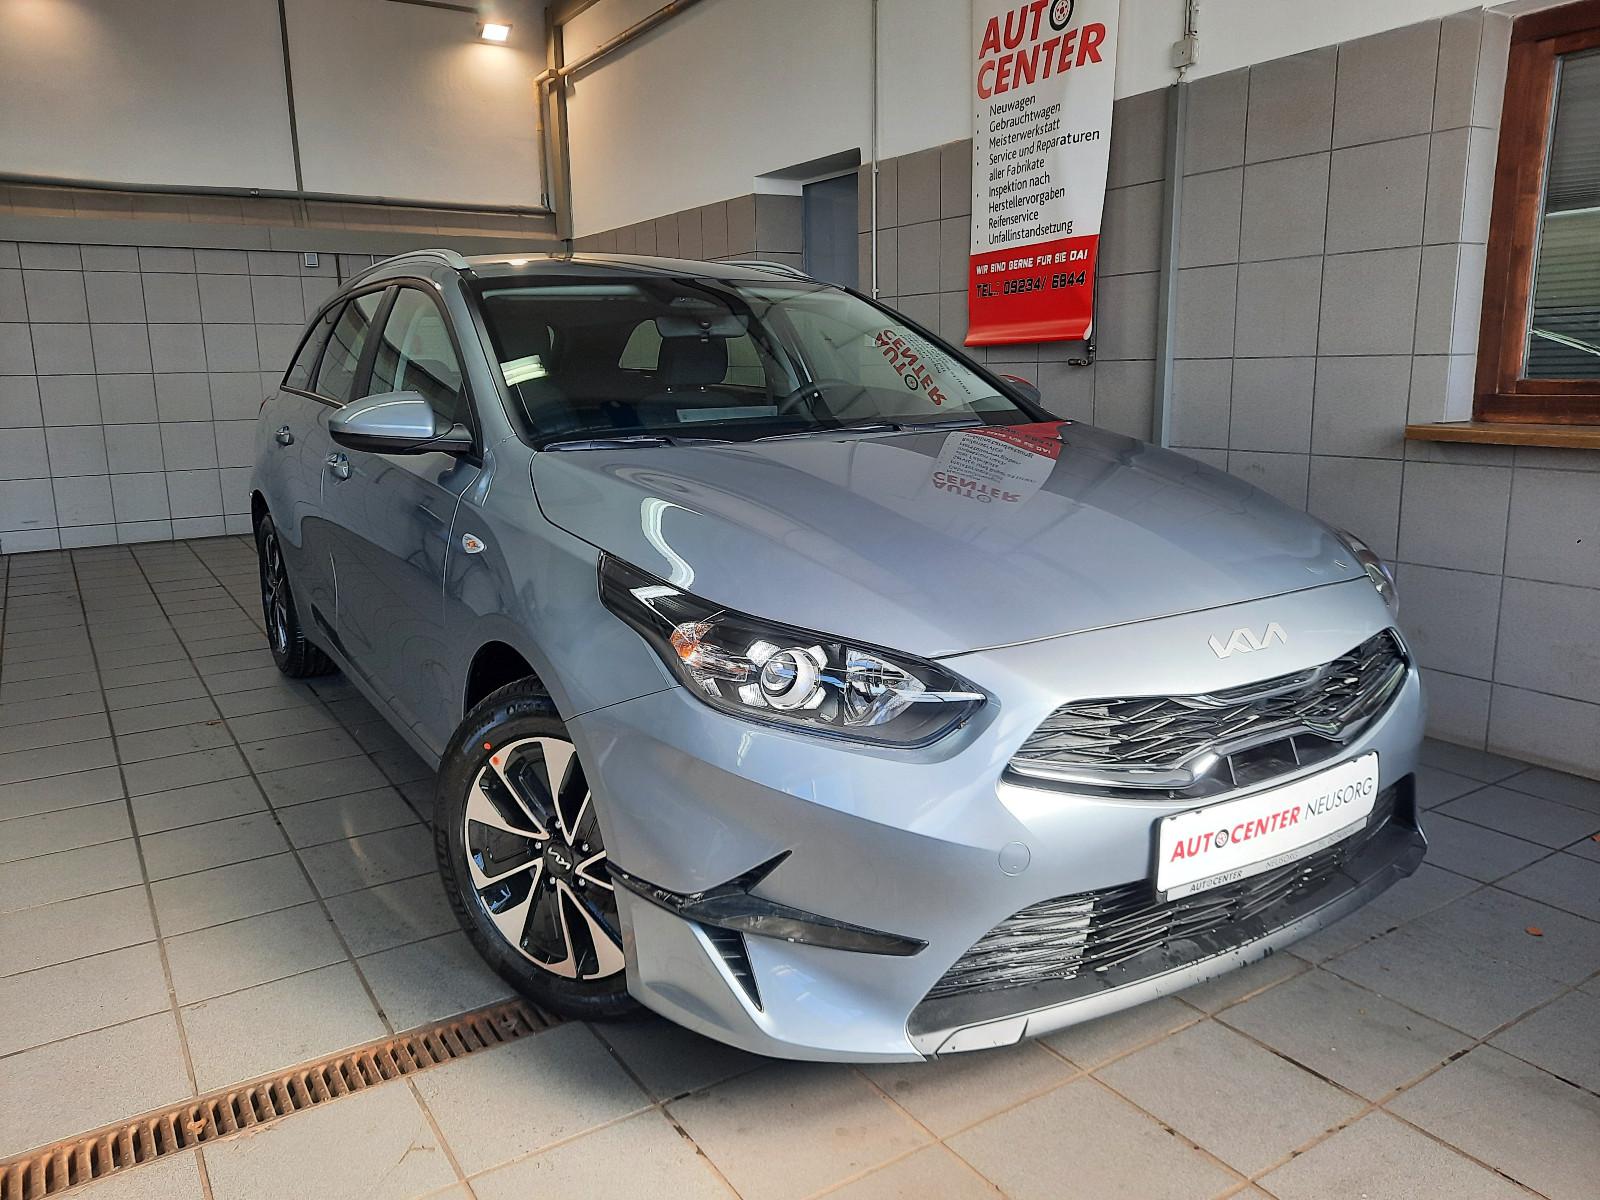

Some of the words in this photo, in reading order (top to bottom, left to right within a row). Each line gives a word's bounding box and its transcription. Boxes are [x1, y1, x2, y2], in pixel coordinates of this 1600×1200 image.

[977, 22, 1106, 100] CENTER
[989, 95, 1036, 117] Neuwagen
[989, 102, 1061, 133] Gebrauchtwagen
[989, 118, 1061, 149] Meisterwerkstatt
[989, 149, 1017, 166] Service
[1018, 141, 1035, 158] und
[1036, 130, 1100, 154] Reparaturen
[989, 167, 1005, 182] aller
[1006, 158, 1045, 177] Fabrikate
[988, 178, 1028, 199] Inspektion
[1029, 170, 1050, 189] nach
[988, 186, 1065, 214] Herstellervorgaben
[988, 209, 1039, 230] Reifenservice
[988, 220, 1073, 245] Unfallinstandsetzung
[976, 264, 988, 275] WIR
[990, 262, 1006, 273] SIND
[1008, 257, 1034, 271] GERNE
[1055, 251, 1067, 263] SIE
[1069, 249, 1088, 261] DA!
[1051, 270, 1086, 289] 6844
[1305, 777, 1373, 820] NEUSORG
